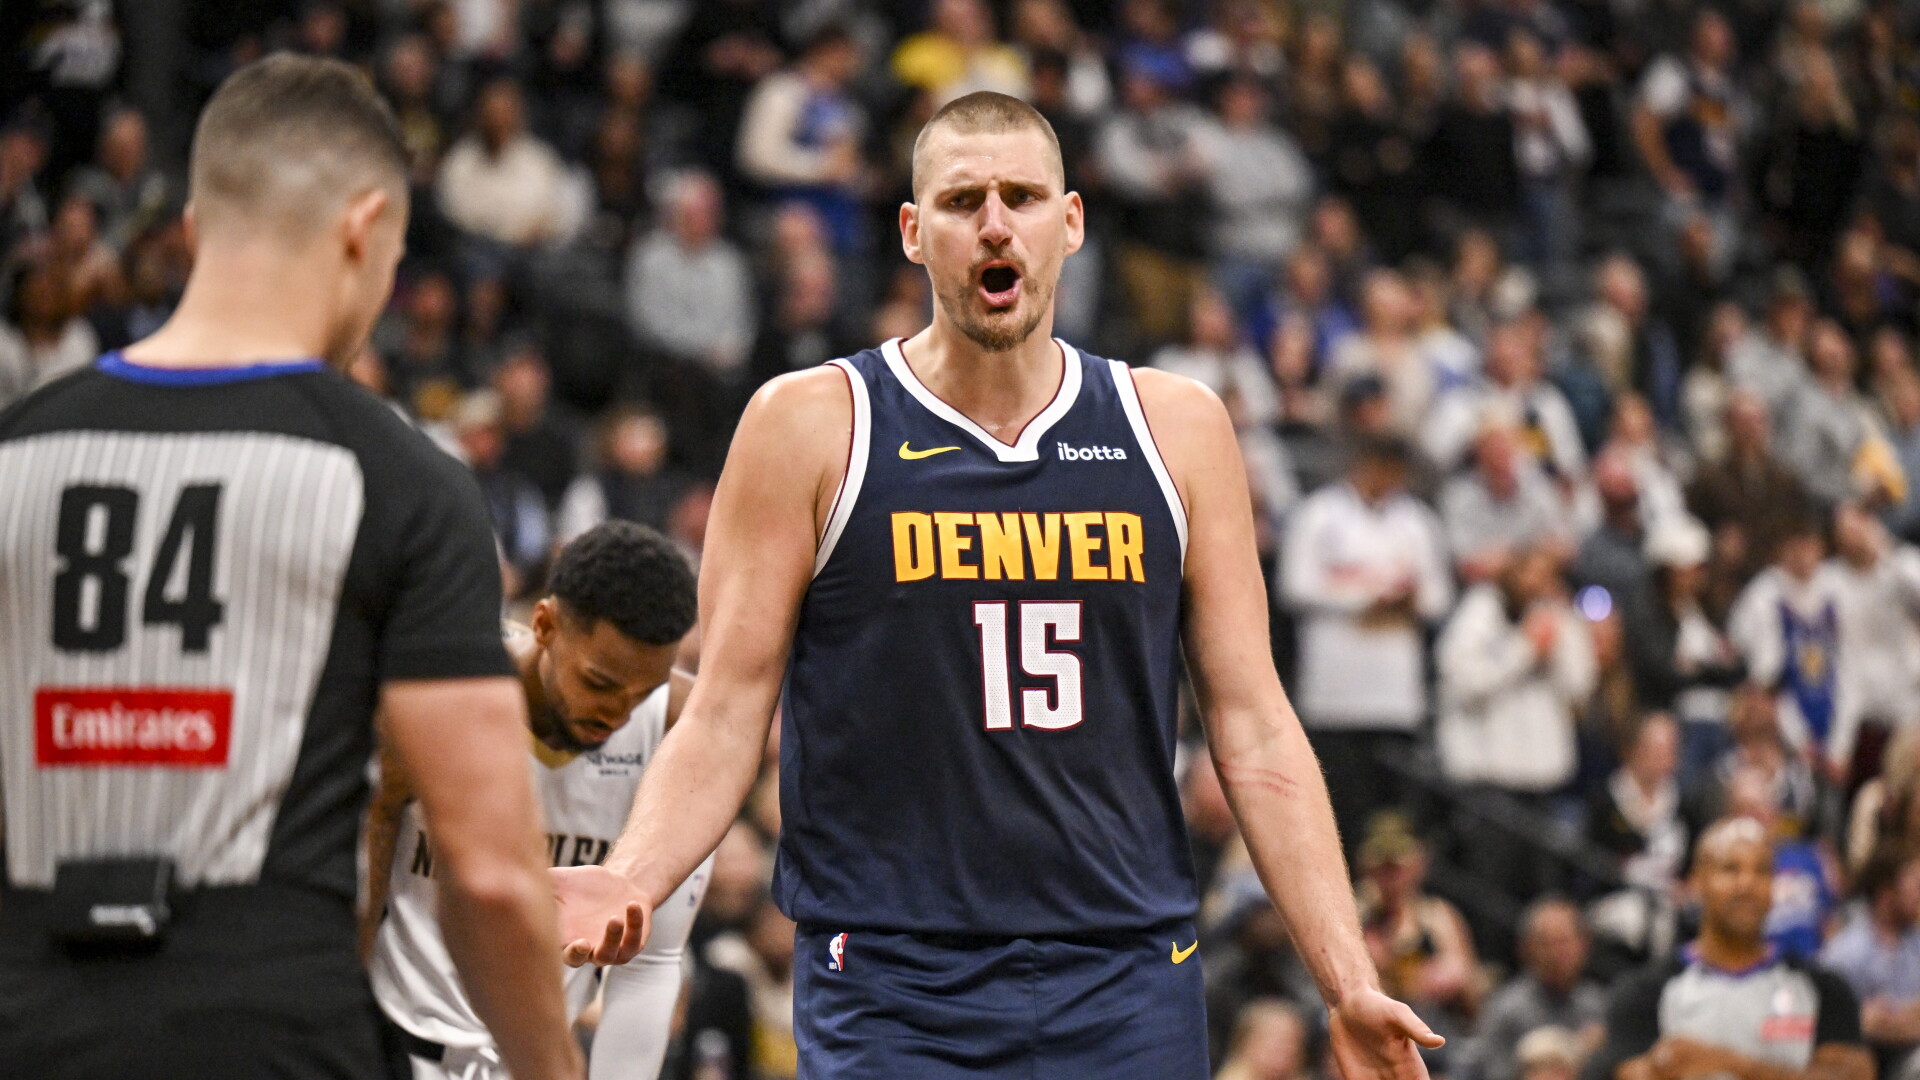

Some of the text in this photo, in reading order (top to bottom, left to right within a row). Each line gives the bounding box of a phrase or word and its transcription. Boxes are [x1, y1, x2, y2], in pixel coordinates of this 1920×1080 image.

[1057, 441, 1127, 461] ibotta
[52, 480, 224, 653] 84
[890, 511, 1146, 584] DENVER
[972, 600, 1086, 731] 15
[51, 702, 215, 752] Emirates
